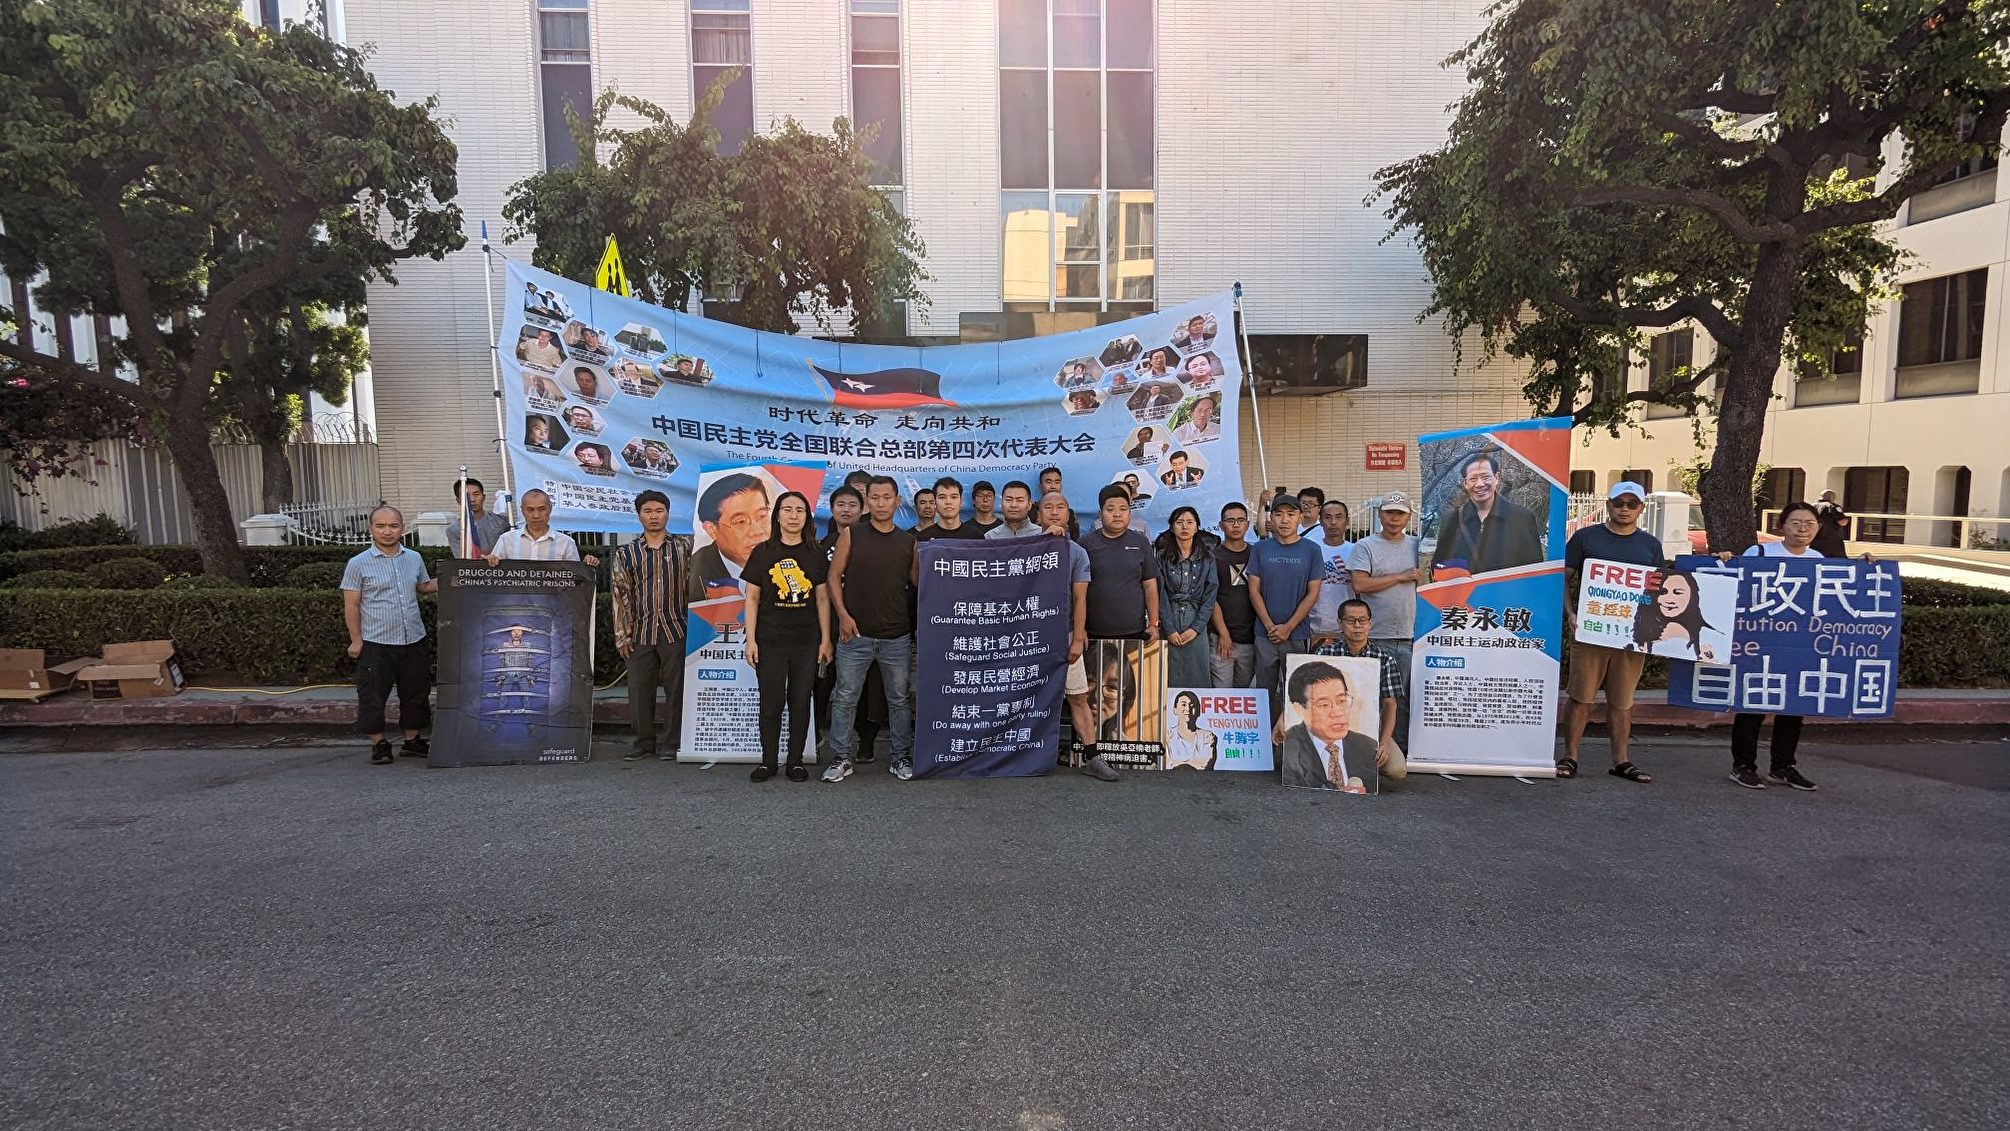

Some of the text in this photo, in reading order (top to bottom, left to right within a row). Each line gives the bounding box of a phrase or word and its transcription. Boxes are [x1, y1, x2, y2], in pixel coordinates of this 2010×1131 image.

[769, 407, 1000, 431] 时代革命 走向共和
[651, 414, 1096, 460] 中国民主党全国联合总部第四次代表大会
[726, 450, 744, 460] The
[839, 462, 871, 471] United
[873, 463, 936, 474] Headquarters
[939, 465, 949, 473] of
[950, 465, 977, 473] China
[979, 463, 1031, 473] Democracy
[1033, 461, 1057, 470] Party
[562, 492, 636, 505] 中国民主党基
[562, 500, 636, 513] 华人参政后援
[458, 569, 576, 579] DRUGGED AND DETAINED:
[459, 578, 576, 588] CHINA'S PSYCHIATRIC PRISONS
[1589, 563, 1662, 591] FREE
[1588, 586, 1628, 602] QIONGYAO
[931, 607, 1060, 625] (Guarantee Basic Human Rights)
[953, 596, 1040, 617] 保障基本人權
[1440, 606, 1533, 632] 秦永敏
[1737, 616, 1892, 639] tution Democracy
[713, 622, 746, 645] 王
[953, 630, 1040, 651] 維護社會公正
[1427, 635, 1546, 650] 中国民主运动政治家
[944, 644, 1050, 663] (Safeguard Social Justice)
[1731, 634, 1878, 657] ee China
[1427, 658, 1464, 668] 人物介绍
[700, 670, 735, 679] 人物介绍
[953, 664, 1040, 685] 發展民營經濟
[941, 676, 1049, 695] (Develop Market Economy)
[1691, 655, 1891, 715] 自由中国
[1200, 696, 1258, 715] FREE
[932, 708, 1051, 731] (Do away with one party ruling)
[1207, 718, 1259, 730] TENGYU NIU
[950, 728, 1031, 752] 建立民主中國
[1019, 739, 1044, 750] China)
[542, 747, 575, 757] safeguard
